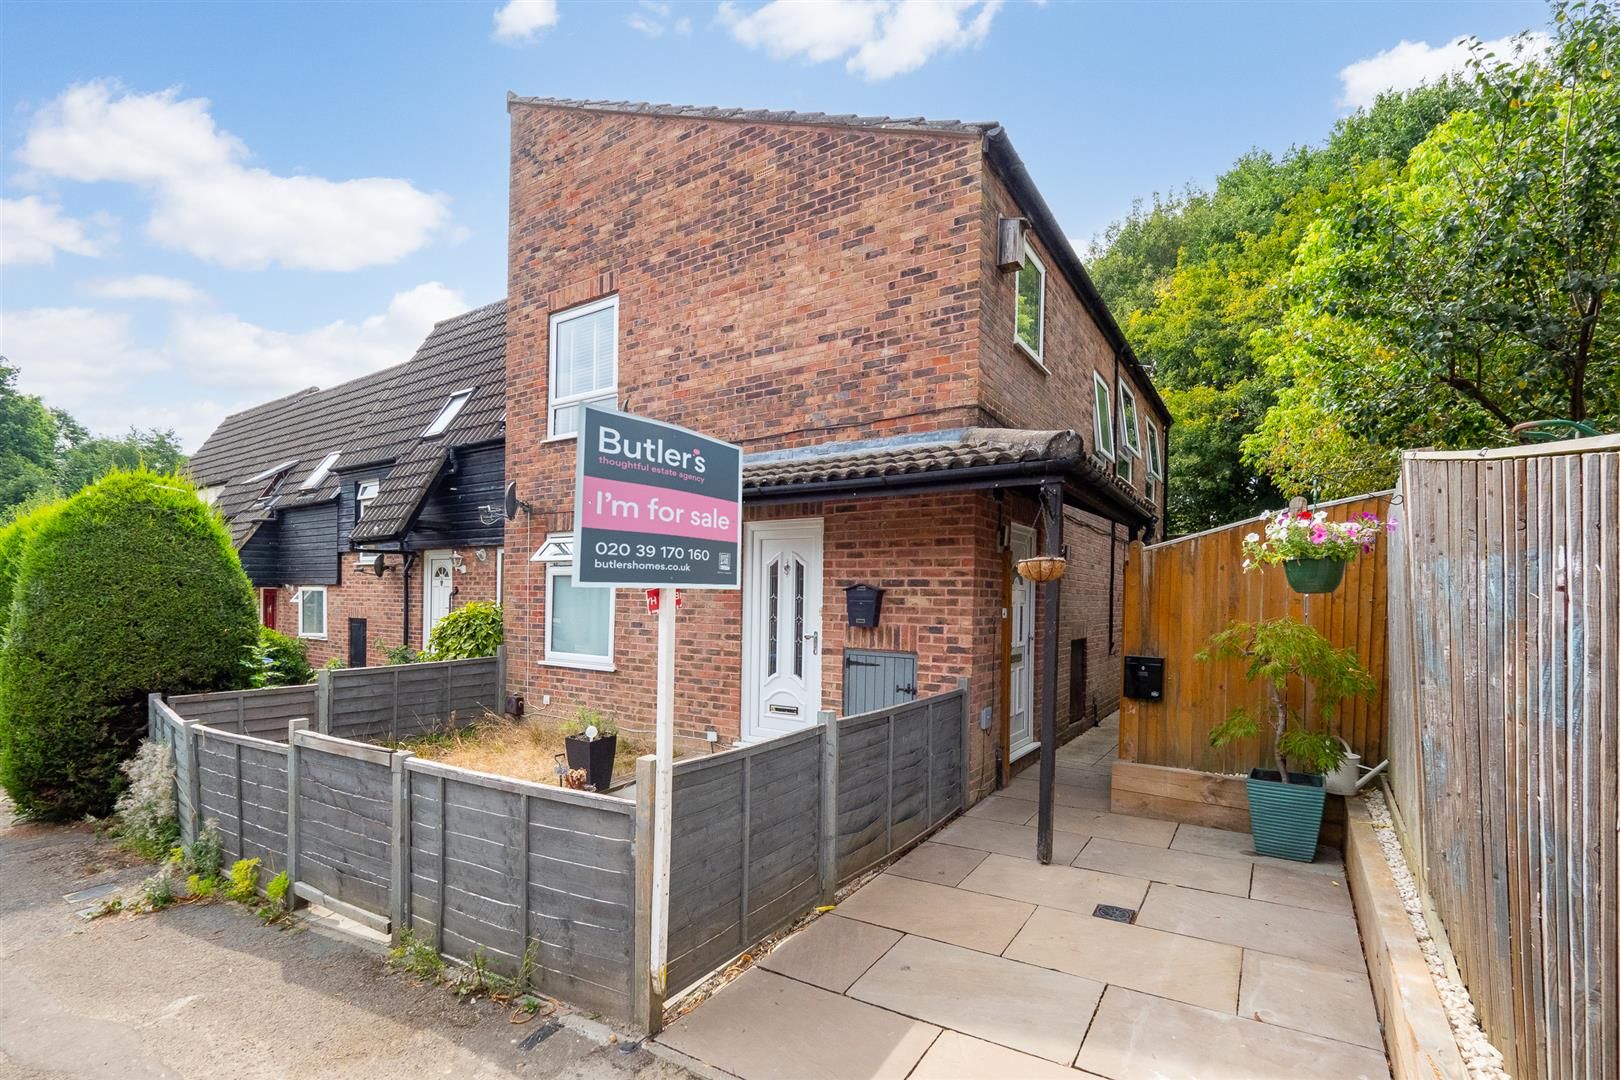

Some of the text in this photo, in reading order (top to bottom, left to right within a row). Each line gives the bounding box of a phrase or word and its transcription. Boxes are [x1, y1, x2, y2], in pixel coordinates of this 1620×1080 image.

[598, 456, 705, 484] thoughtful estate agency
[596, 490, 730, 530] I'm for sale
[595, 542, 710, 561] 020 39 170 160
[594, 559, 691, 572] butlershomes.co.uk
